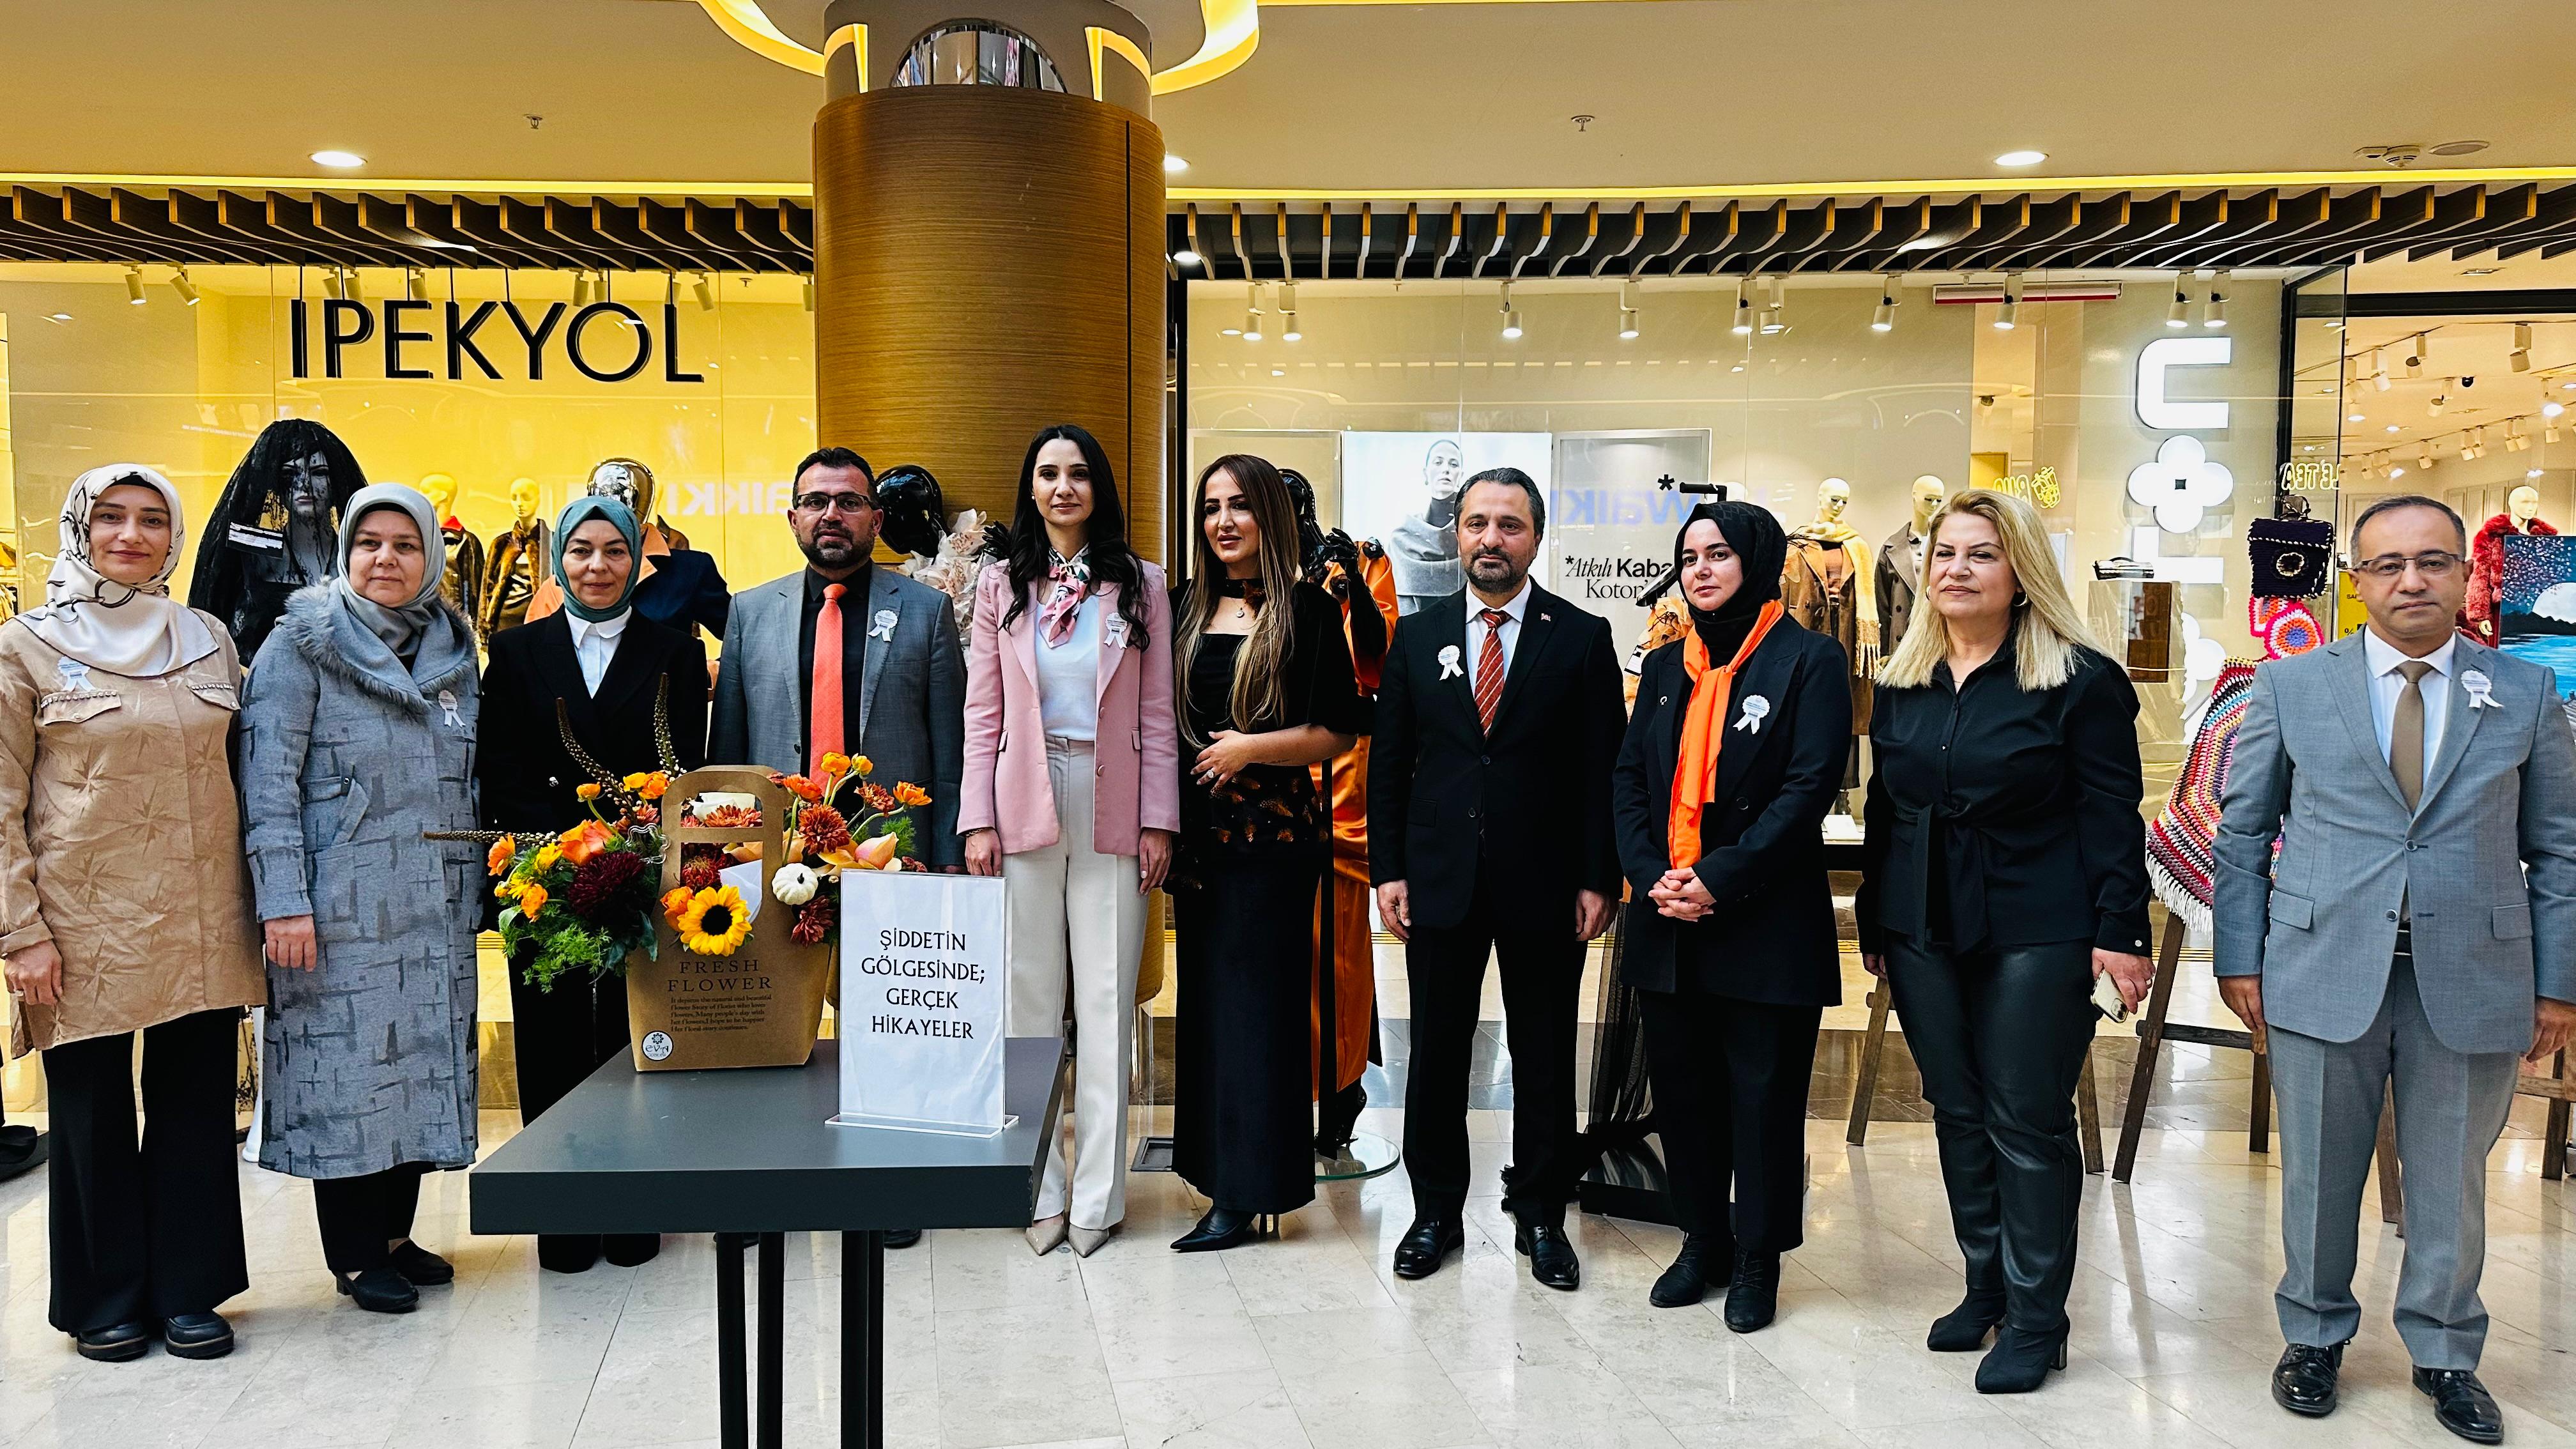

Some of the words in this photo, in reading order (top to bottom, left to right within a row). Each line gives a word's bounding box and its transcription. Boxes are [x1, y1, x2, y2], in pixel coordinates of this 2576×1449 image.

[291, 298, 704, 383] IPEKYOL
[880, 927, 966, 951] ŞİDDETİN
[679, 959, 759, 974] FRESH
[861, 954, 985, 985] GÖLGESİNDE;
[667, 976, 773, 992] FLOWER
[885, 988, 959, 1011] GERÇEK
[871, 1014, 974, 1039] HİKAYELER
